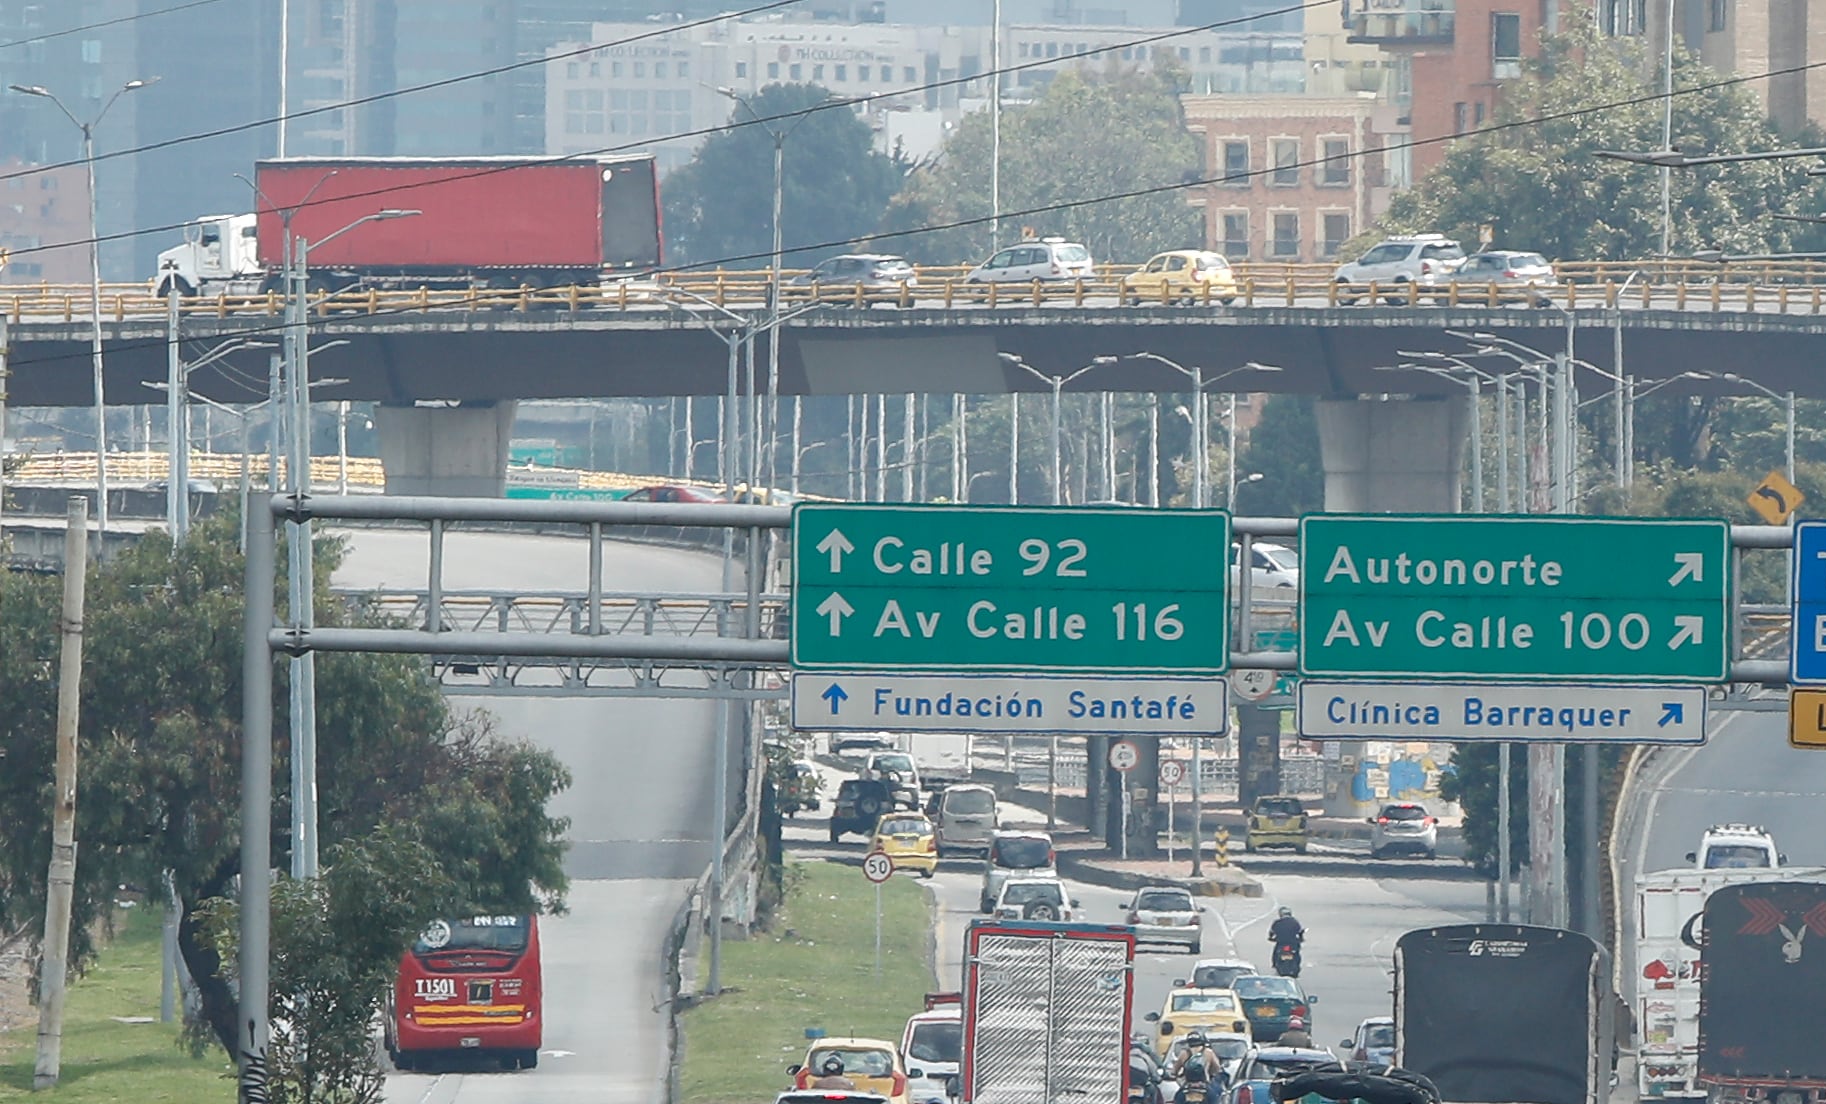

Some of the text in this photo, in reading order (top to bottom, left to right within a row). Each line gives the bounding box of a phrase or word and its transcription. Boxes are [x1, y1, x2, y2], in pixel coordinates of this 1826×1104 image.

[873, 536, 1088, 578] Calle 92
[1323, 545, 1564, 587] Autonorte
[873, 600, 1185, 642] Av Calle 116
[1323, 609, 1652, 651] Av Calle 100
[874, 687, 1197, 721] Fundación Santafé
[1327, 696, 1633, 733] Clínica Barraquer
[1163, 766, 1180, 778] 50
[869, 859, 888, 875] 50
